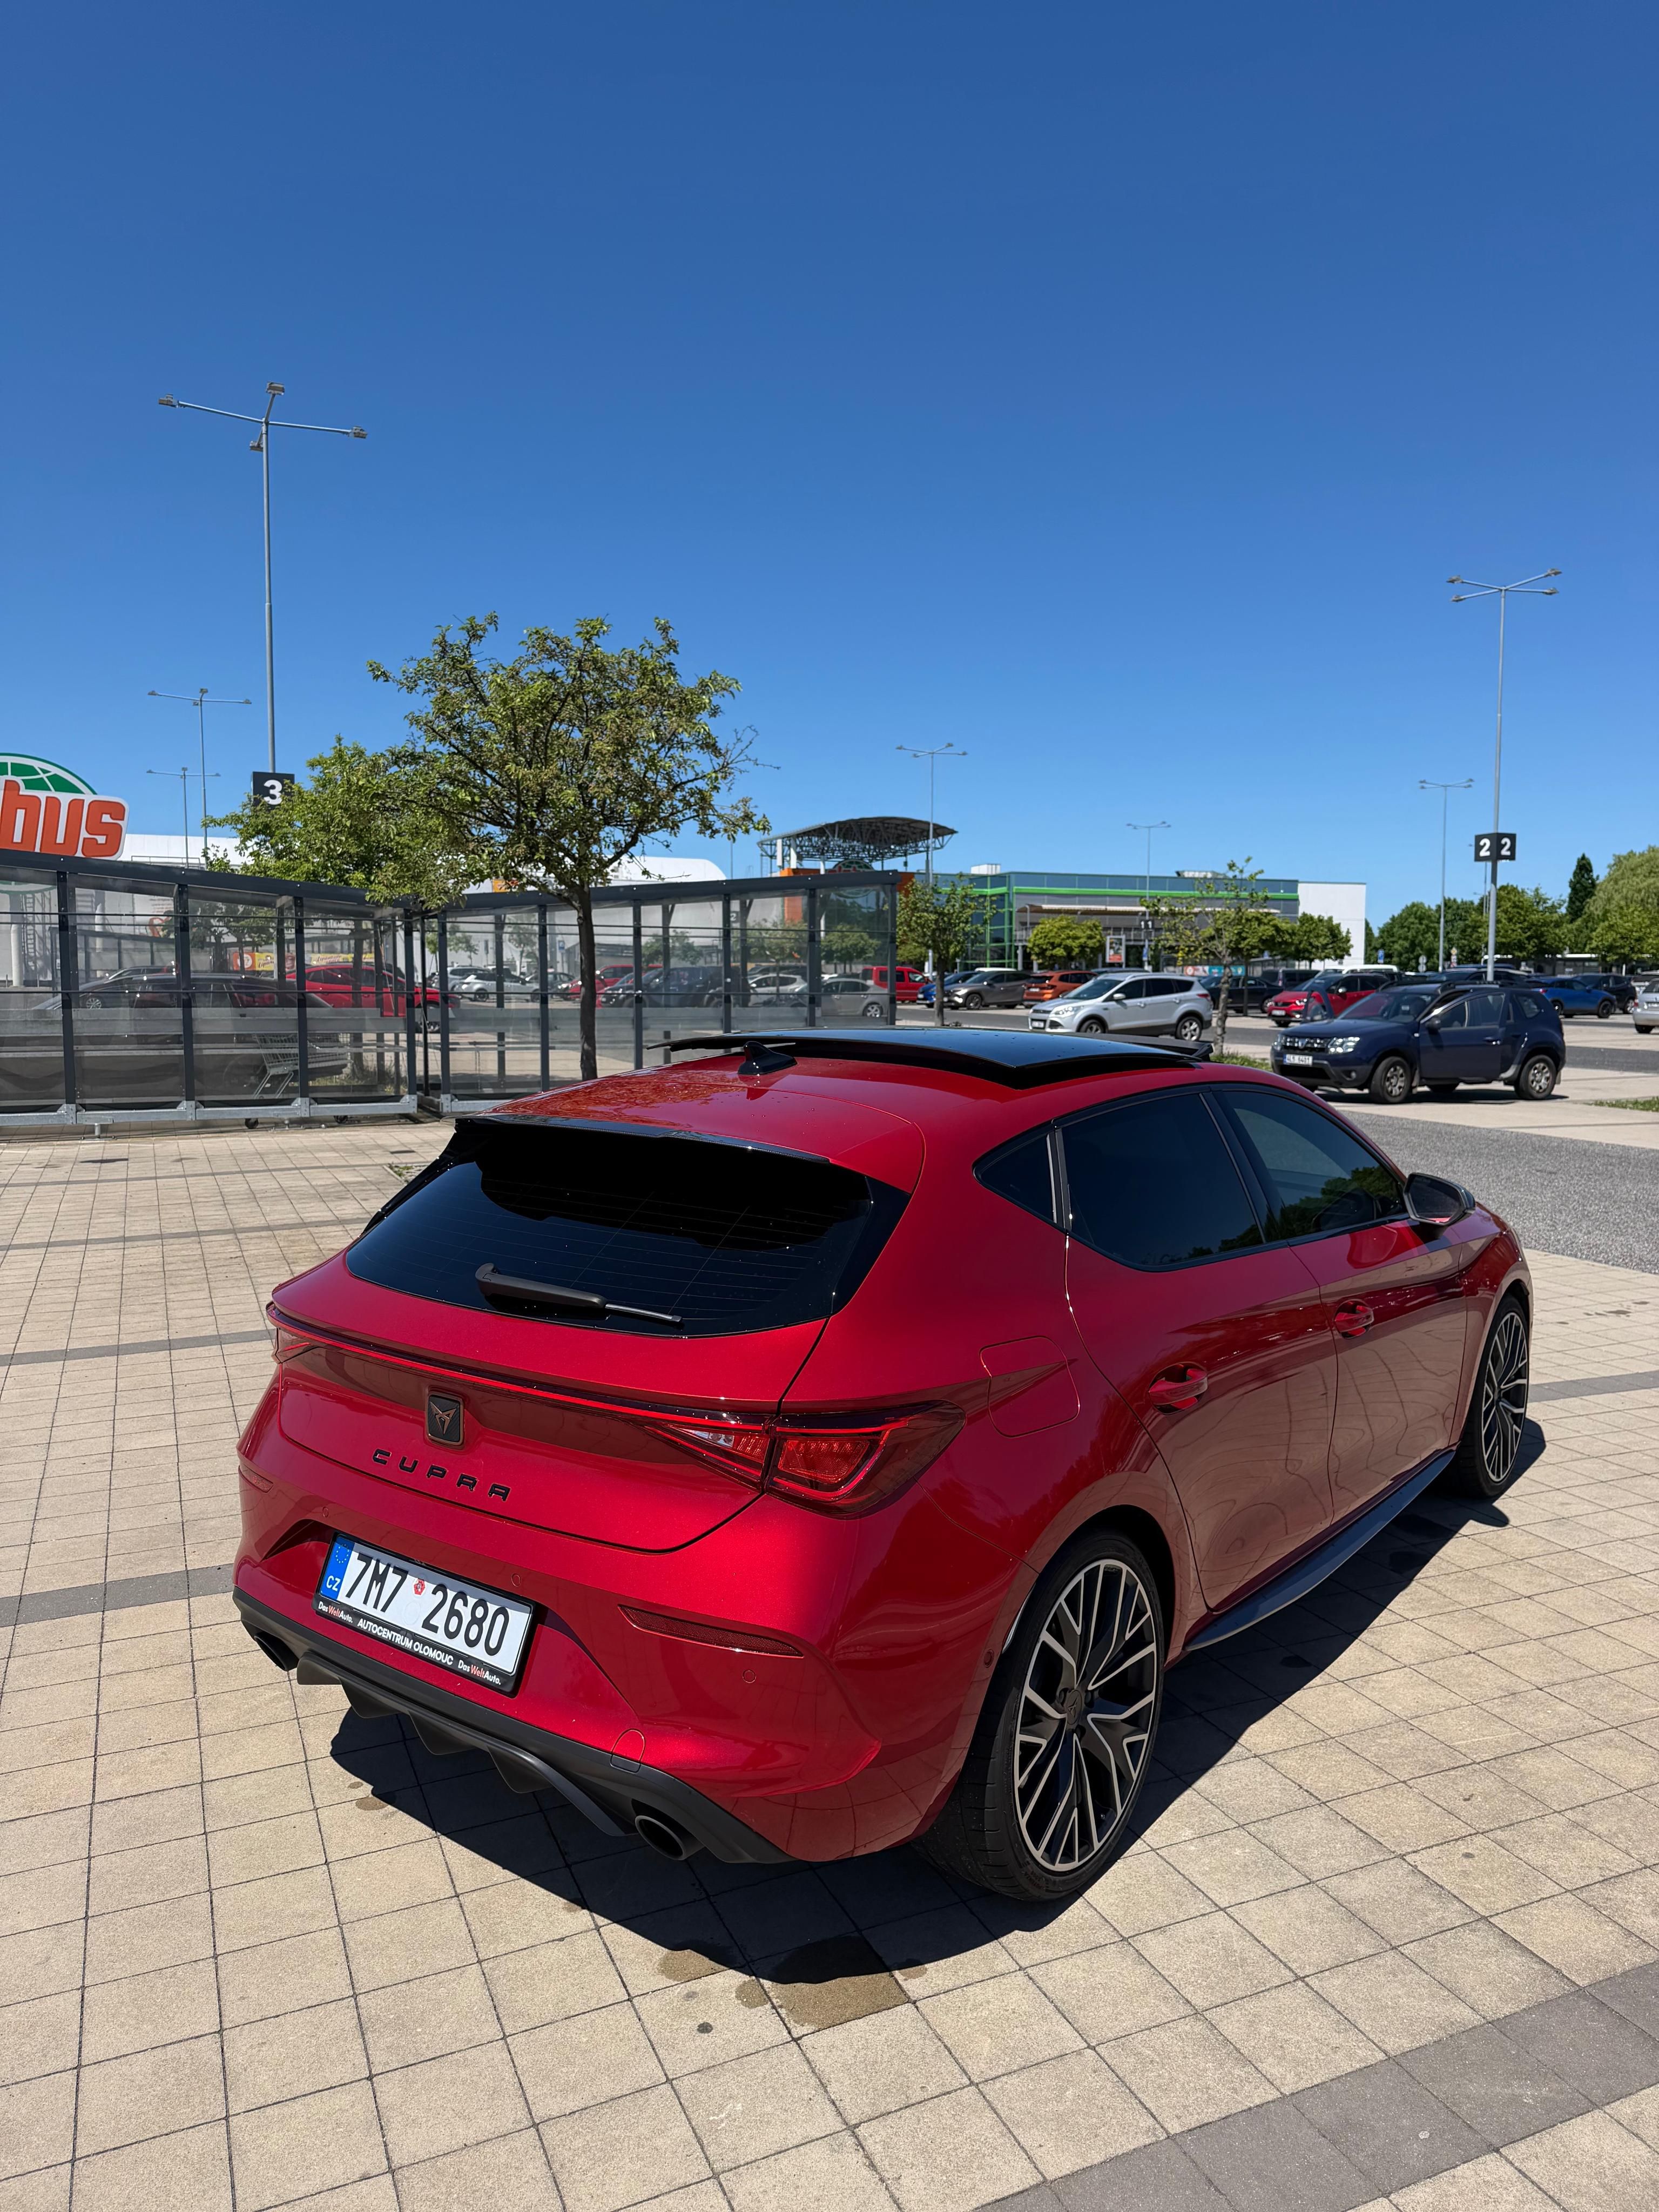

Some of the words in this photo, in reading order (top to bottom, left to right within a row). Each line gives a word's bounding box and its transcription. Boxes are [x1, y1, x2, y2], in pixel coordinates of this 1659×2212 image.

[264, 779, 282, 805] 3
[1479, 838, 1491, 857] 2
[1501, 837, 1511, 855] 2
[373, 1448, 511, 1501] CUPRA
[326, 1575, 341, 1591] CZ
[345, 1552, 409, 1613] 7M7
[422, 1583, 509, 1656] 2680
[357, 1618, 413, 1650] AUTOCENTRUM
[413, 1642, 454, 1665] OLOMOUC
